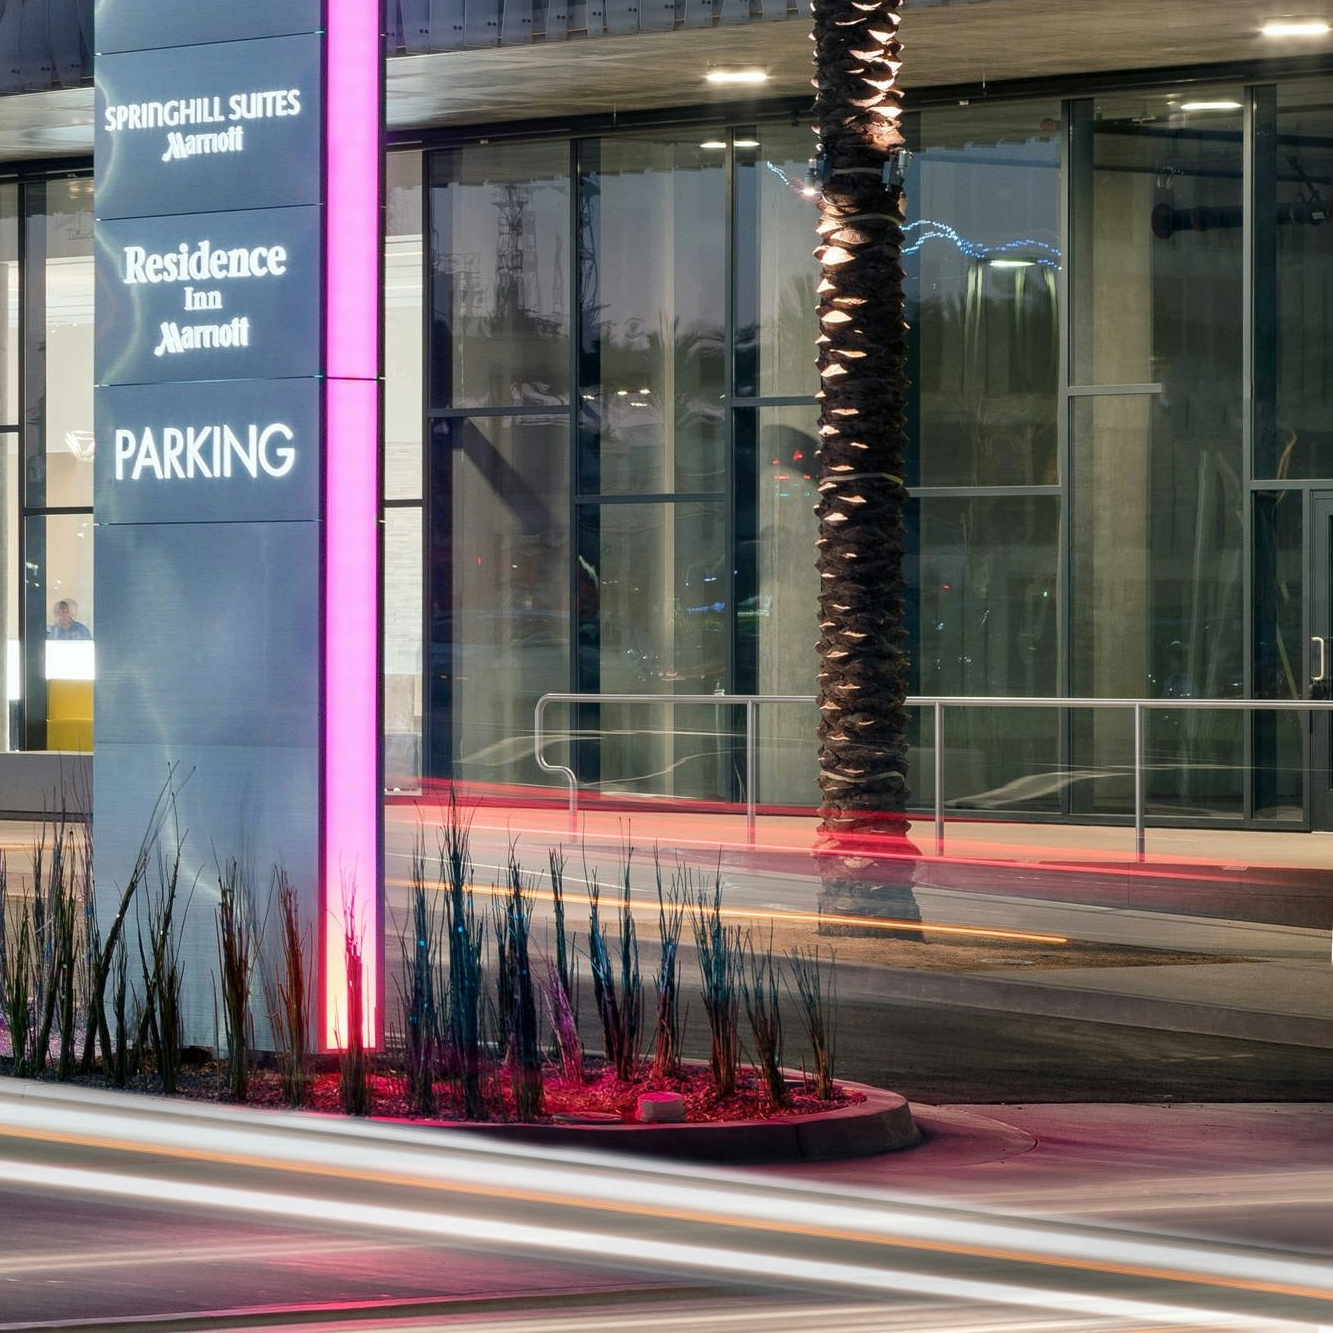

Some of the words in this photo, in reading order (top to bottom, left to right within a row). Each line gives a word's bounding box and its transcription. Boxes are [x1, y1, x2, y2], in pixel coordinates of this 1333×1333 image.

[104, 96, 225, 132] SPRINGHILL
[228, 89, 302, 121] SUITES
[161, 125, 244, 163] Marriott
[123, 239, 287, 284] Residence
[183, 286, 223, 311] Inn
[153, 316, 250, 357] Marriott
[115, 421, 295, 481] PARKING
